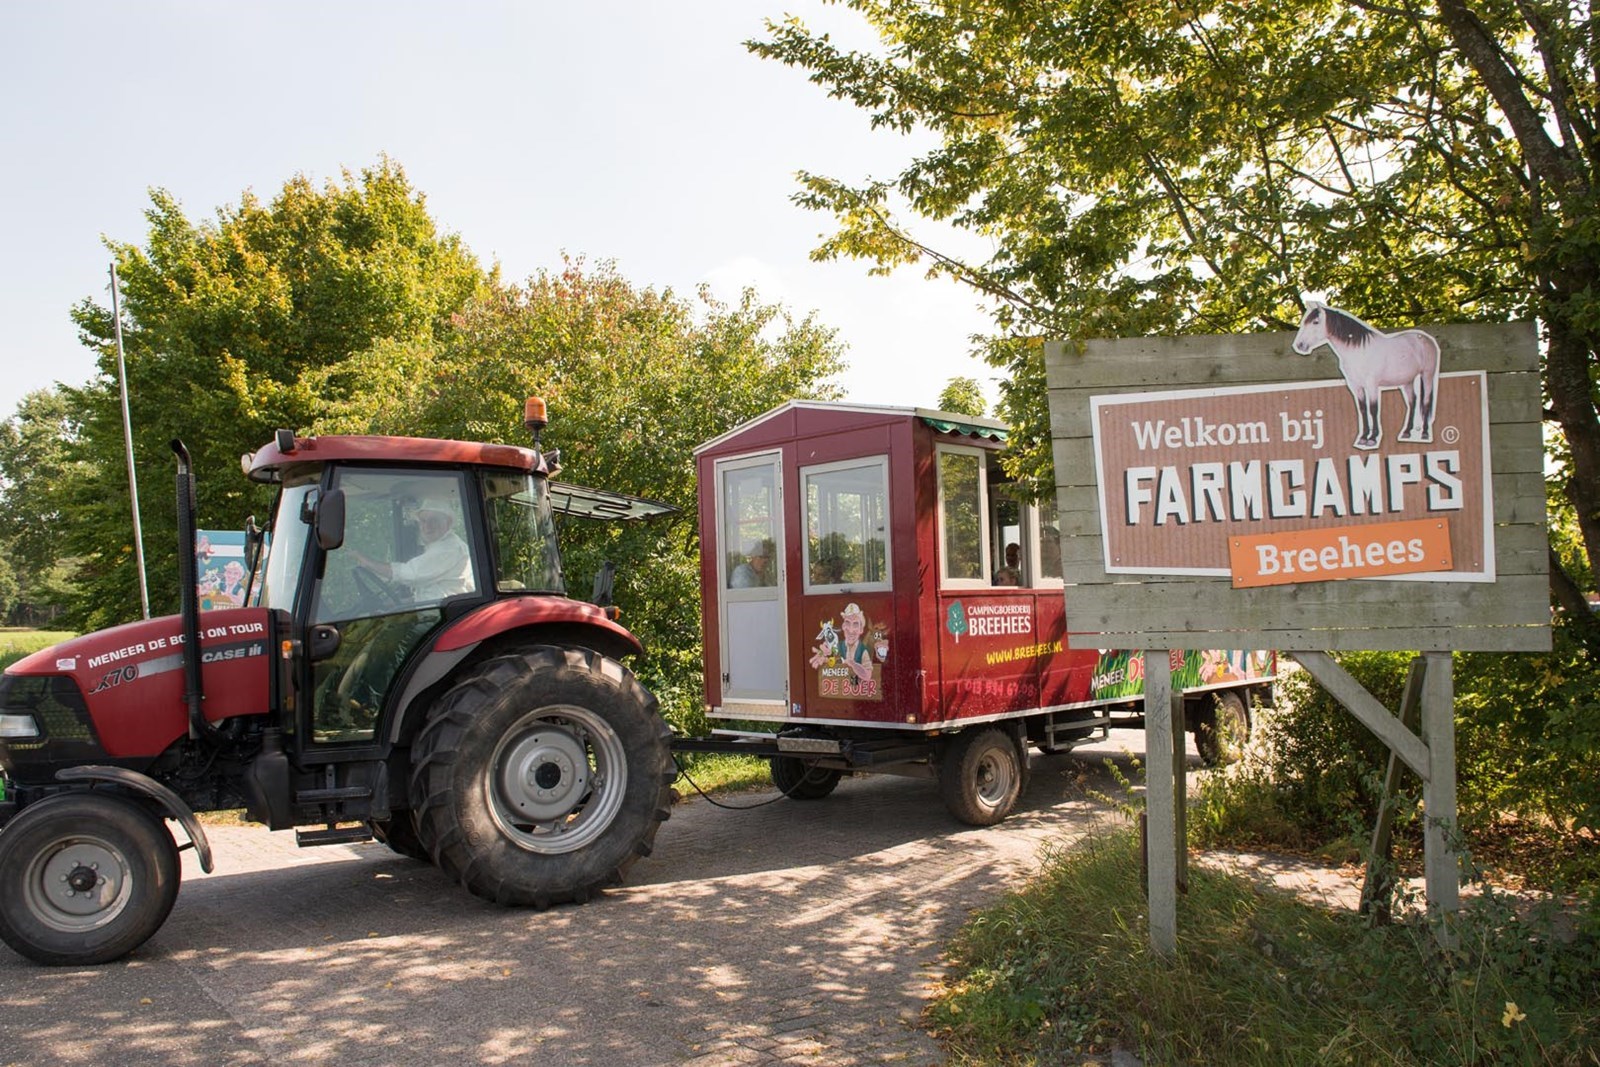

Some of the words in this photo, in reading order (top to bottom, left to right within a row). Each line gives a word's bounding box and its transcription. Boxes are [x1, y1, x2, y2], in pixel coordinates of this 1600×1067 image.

[1131, 417, 1270, 450] Welkom
[1279, 410, 1325, 449] bij
[1124, 449, 1464, 526] FARMCAMPS
[1255, 536, 1425, 576] Breehees
[968, 615, 1032, 636] BREEHEES
[88, 643, 146, 669] MENEER
[148, 638, 167, 651] DE
[169, 630, 205, 646] BOR
[207, 626, 227, 638] ON
[229, 622, 263, 635] TOUR
[201, 648, 246, 663] CASE
[986, 641, 1063, 666] WWW.BREEHEES.NL
[822, 667, 849, 677] MENEER
[1091, 668, 1125, 691] MENEER
[822, 678, 839, 696] DE
[842, 679, 877, 697] BOER
